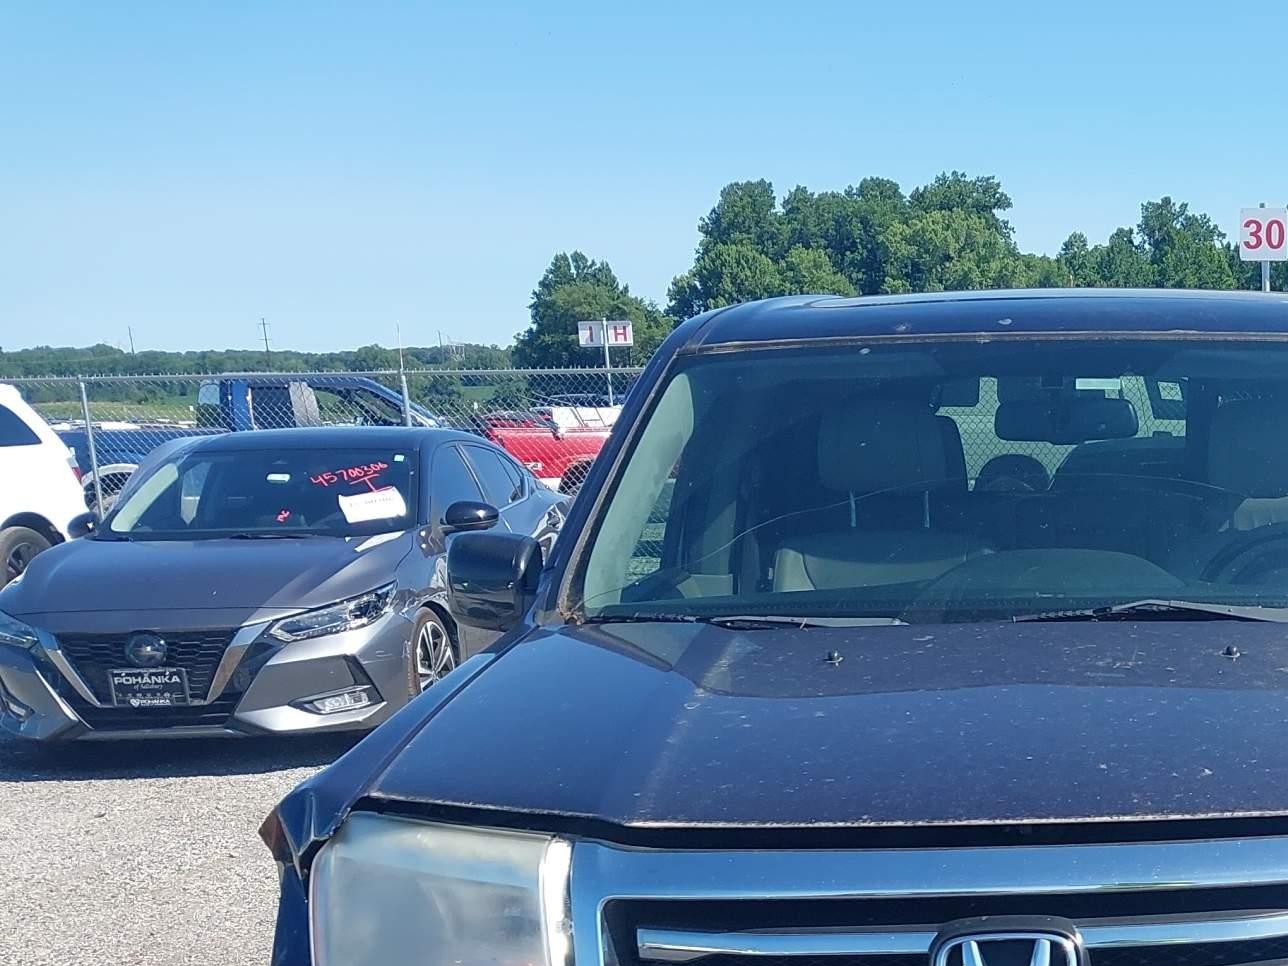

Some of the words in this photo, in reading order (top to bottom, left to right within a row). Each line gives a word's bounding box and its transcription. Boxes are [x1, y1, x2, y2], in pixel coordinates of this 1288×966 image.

[1243, 219, 1285, 250] 30
[613, 325, 628, 342] H
[310, 461, 389, 488] 45700306
[114, 675, 181, 685] POHANKA
